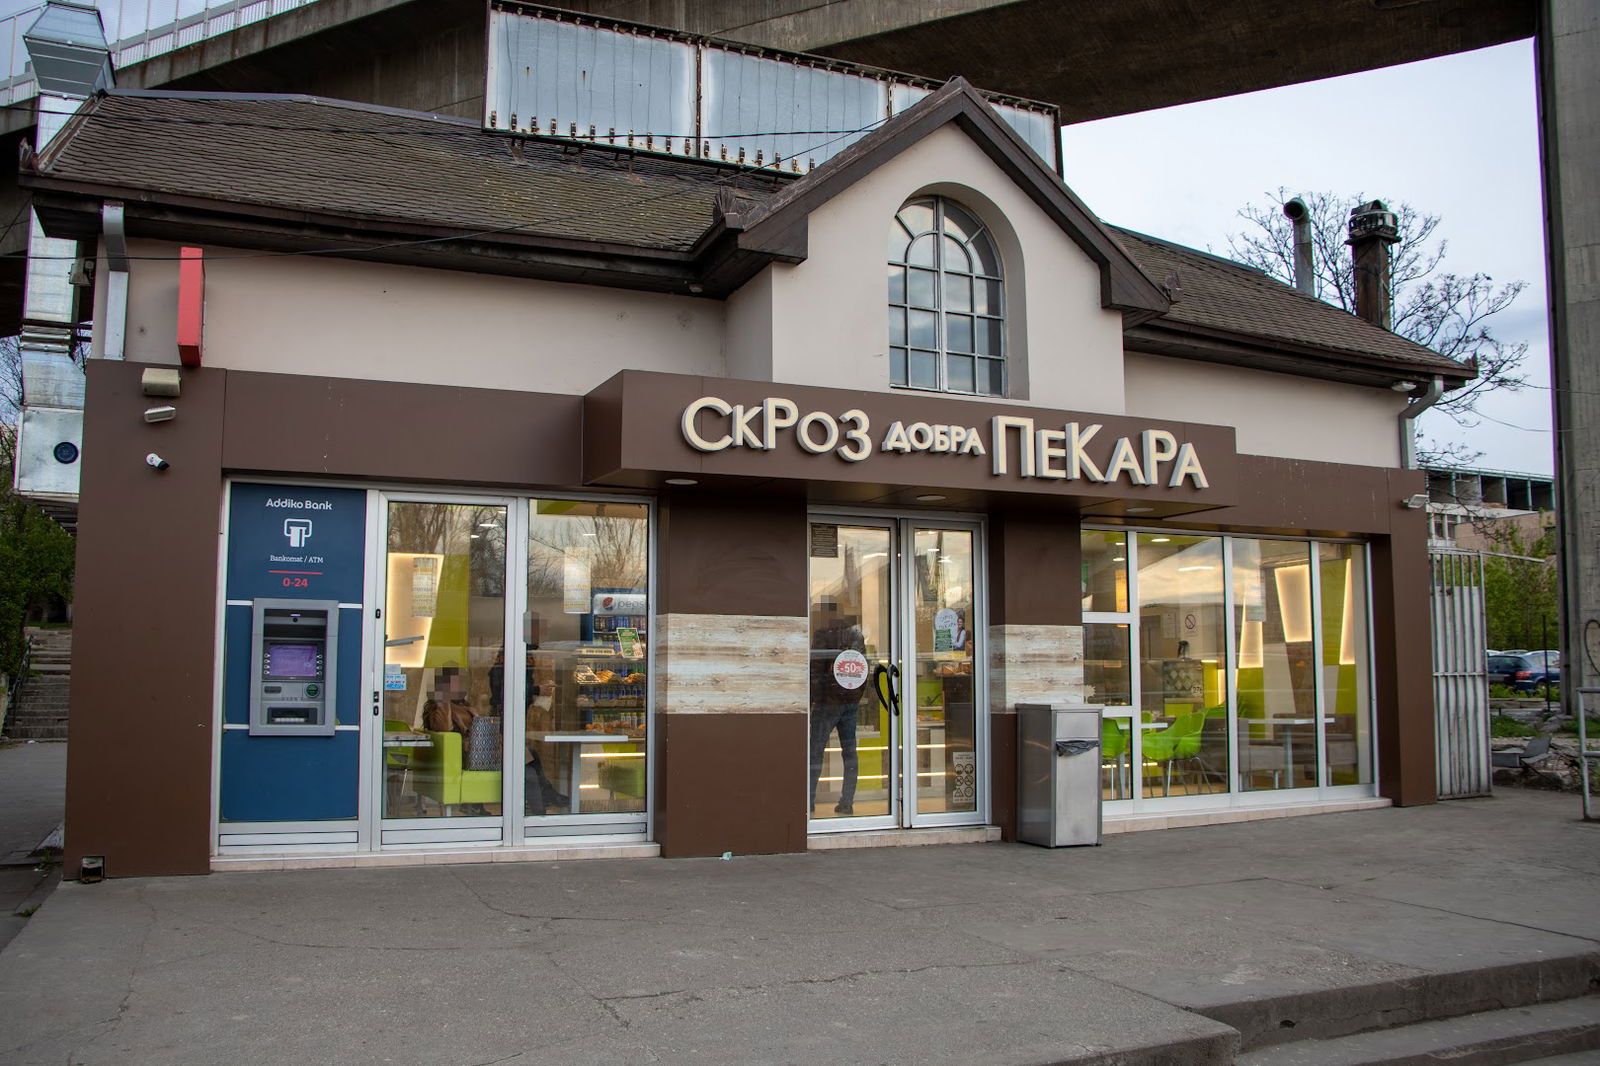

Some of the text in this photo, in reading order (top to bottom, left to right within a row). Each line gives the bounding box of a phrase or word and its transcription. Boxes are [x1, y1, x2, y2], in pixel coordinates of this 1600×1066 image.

[266, 498, 332, 510] Addiko Bank
[270, 554, 303, 562] Bankomat
[308, 556, 324, 564] ATM
[282, 577, 308, 588] 0-24
[618, 600, 645, 609] peps
